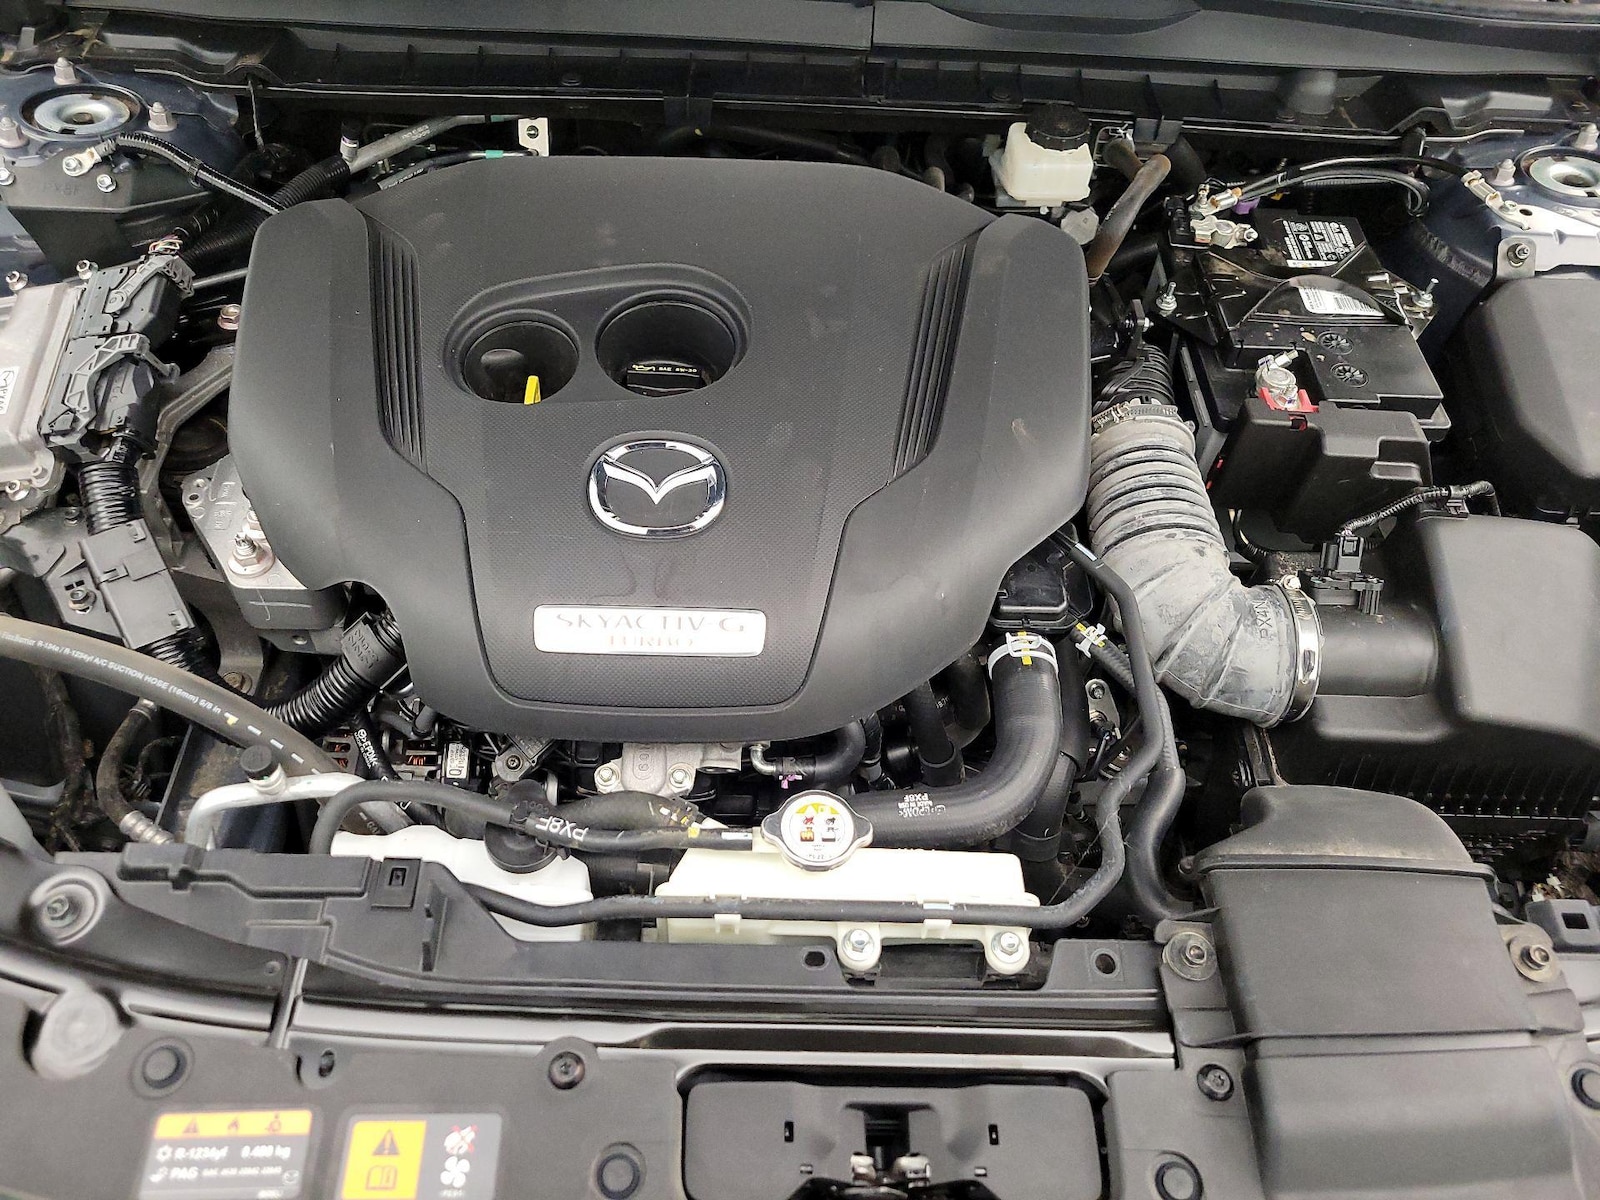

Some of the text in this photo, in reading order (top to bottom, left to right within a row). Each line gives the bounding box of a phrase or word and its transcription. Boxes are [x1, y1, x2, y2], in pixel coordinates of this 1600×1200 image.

[94, 656, 108, 667] A/C
[107, 661, 144, 680] SUCTION
[144, 674, 170, 690] HOSE
[535, 815, 589, 842] PX8F
